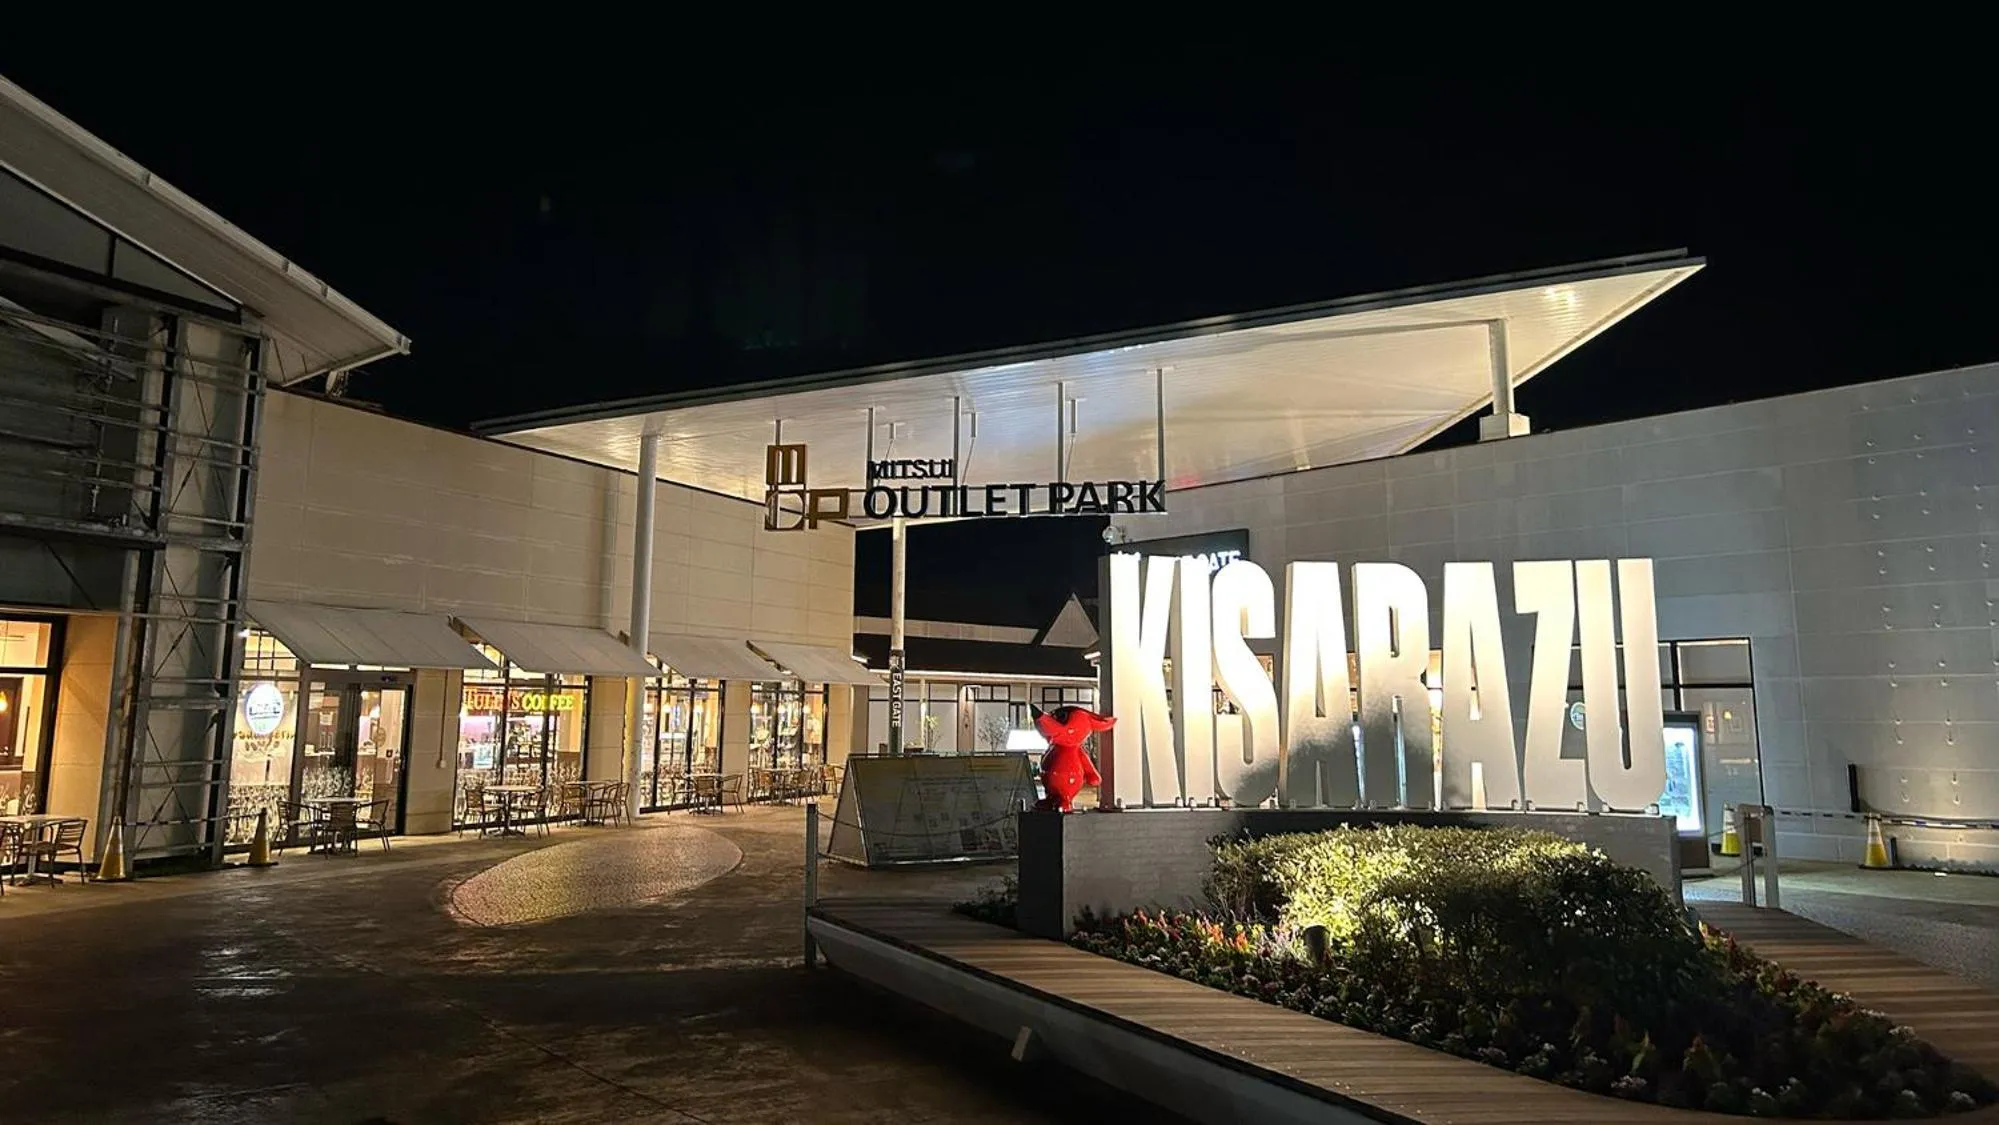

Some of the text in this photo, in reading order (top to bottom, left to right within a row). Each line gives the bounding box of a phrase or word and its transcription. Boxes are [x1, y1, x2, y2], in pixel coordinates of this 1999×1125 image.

[868, 458, 954, 480] MITSUI
[863, 480, 1167, 519] OUTLET PARK
[1197, 551, 1241, 572] ATE
[1108, 555, 1668, 809] KISARAZU
[464, 689, 523, 711] TULL'S
[892, 672, 902, 727] EAST GATE
